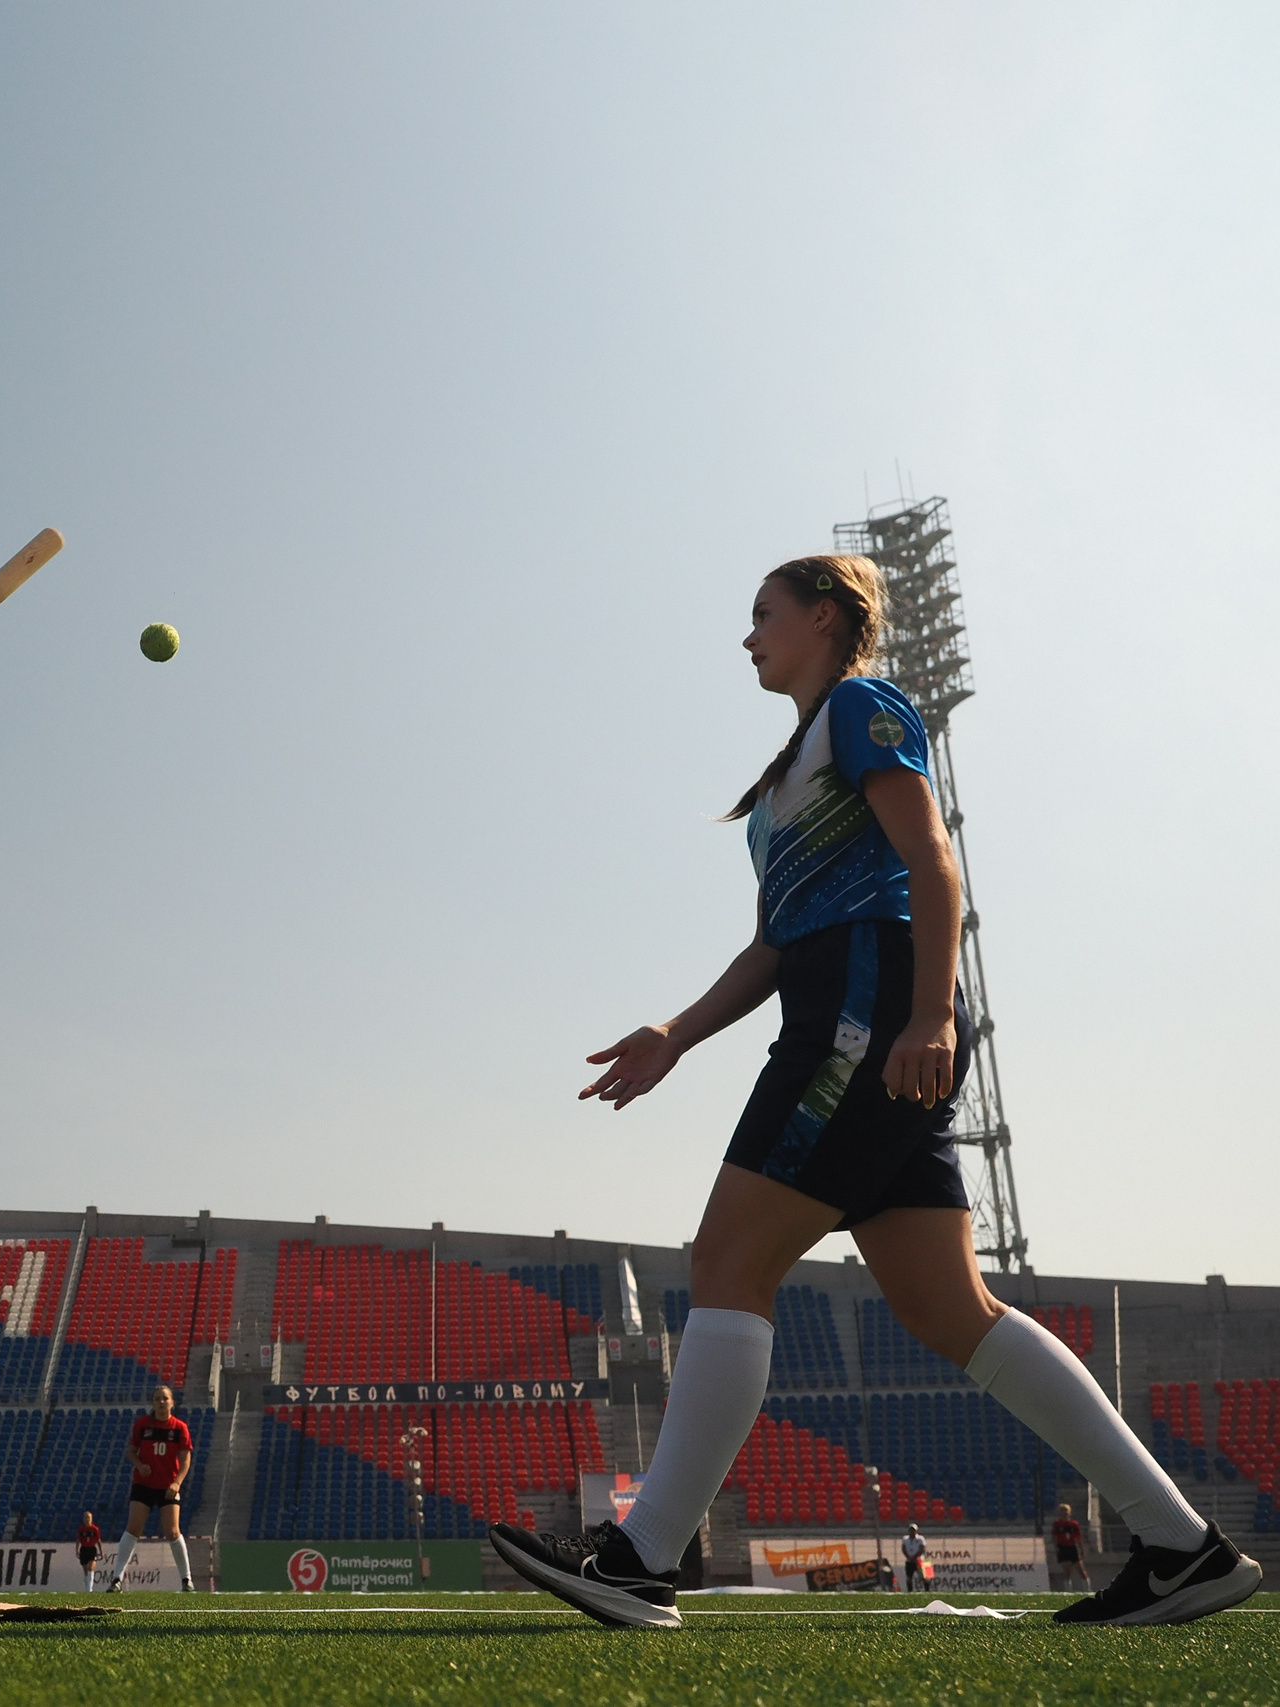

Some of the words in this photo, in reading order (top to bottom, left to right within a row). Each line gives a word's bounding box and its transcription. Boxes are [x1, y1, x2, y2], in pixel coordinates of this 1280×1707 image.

[285, 1385, 397, 1402] ФУТБОЛ
[417, 1382, 585, 1400] ПО-НОВОМУ
[153, 1442, 166, 1456] 10
[925, 1550, 971, 1559] КЛАМА
[331, 1556, 413, 1572] Пятёрочка
[93, 1569, 160, 1585] ОМАНИЙ
[813, 1562, 877, 1586] СЕРВИС
